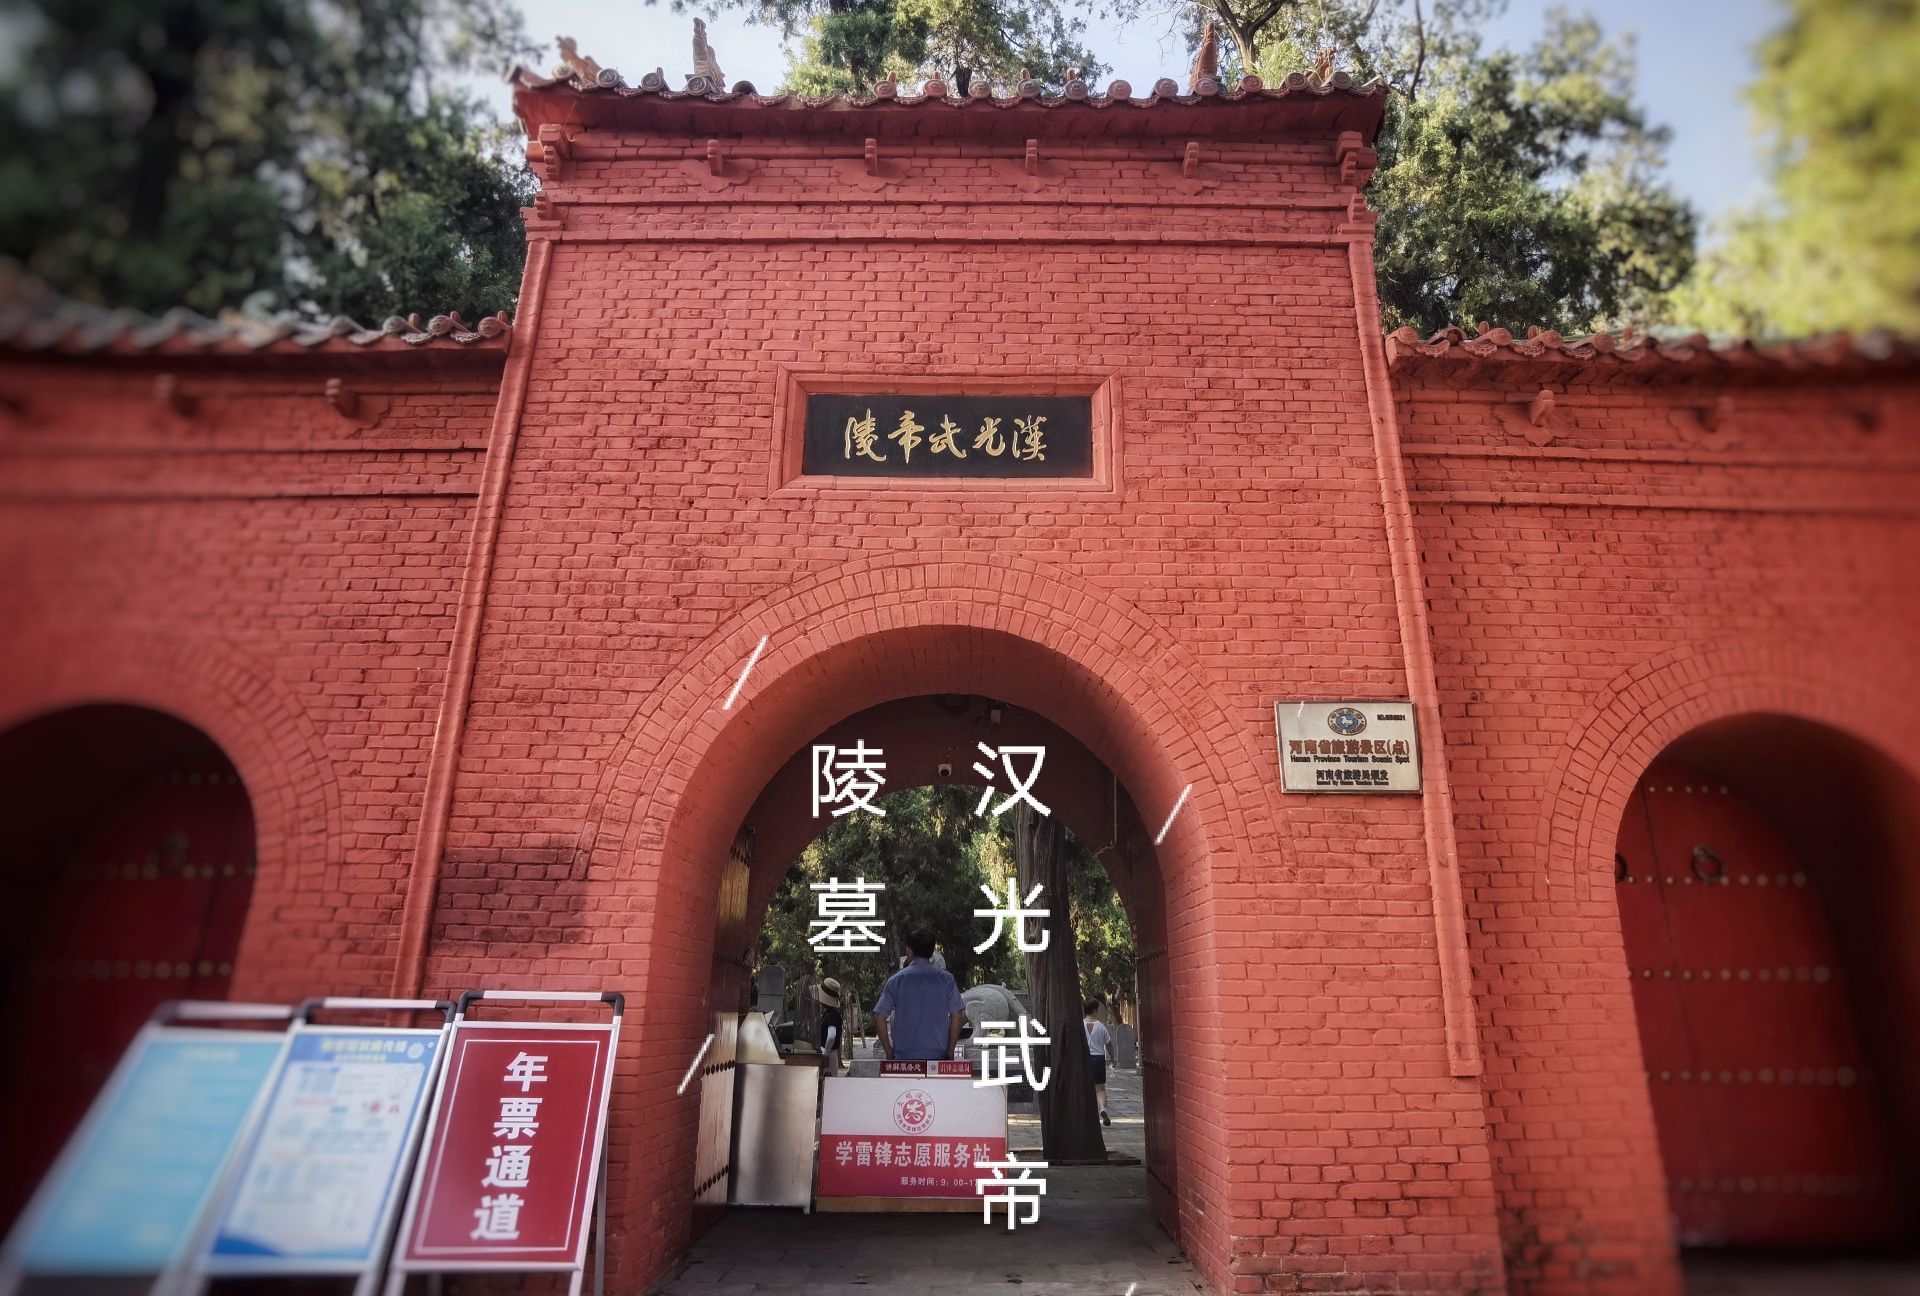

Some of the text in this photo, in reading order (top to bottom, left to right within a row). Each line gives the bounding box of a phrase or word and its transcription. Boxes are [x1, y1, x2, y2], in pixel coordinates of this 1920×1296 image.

[1290, 755, 1410, 765] Henan Province Tourism Scenic Spot
[470, 1052, 549, 1240] 年票通道
[835, 1141, 991, 1168] 学雷锋志愿服务站
